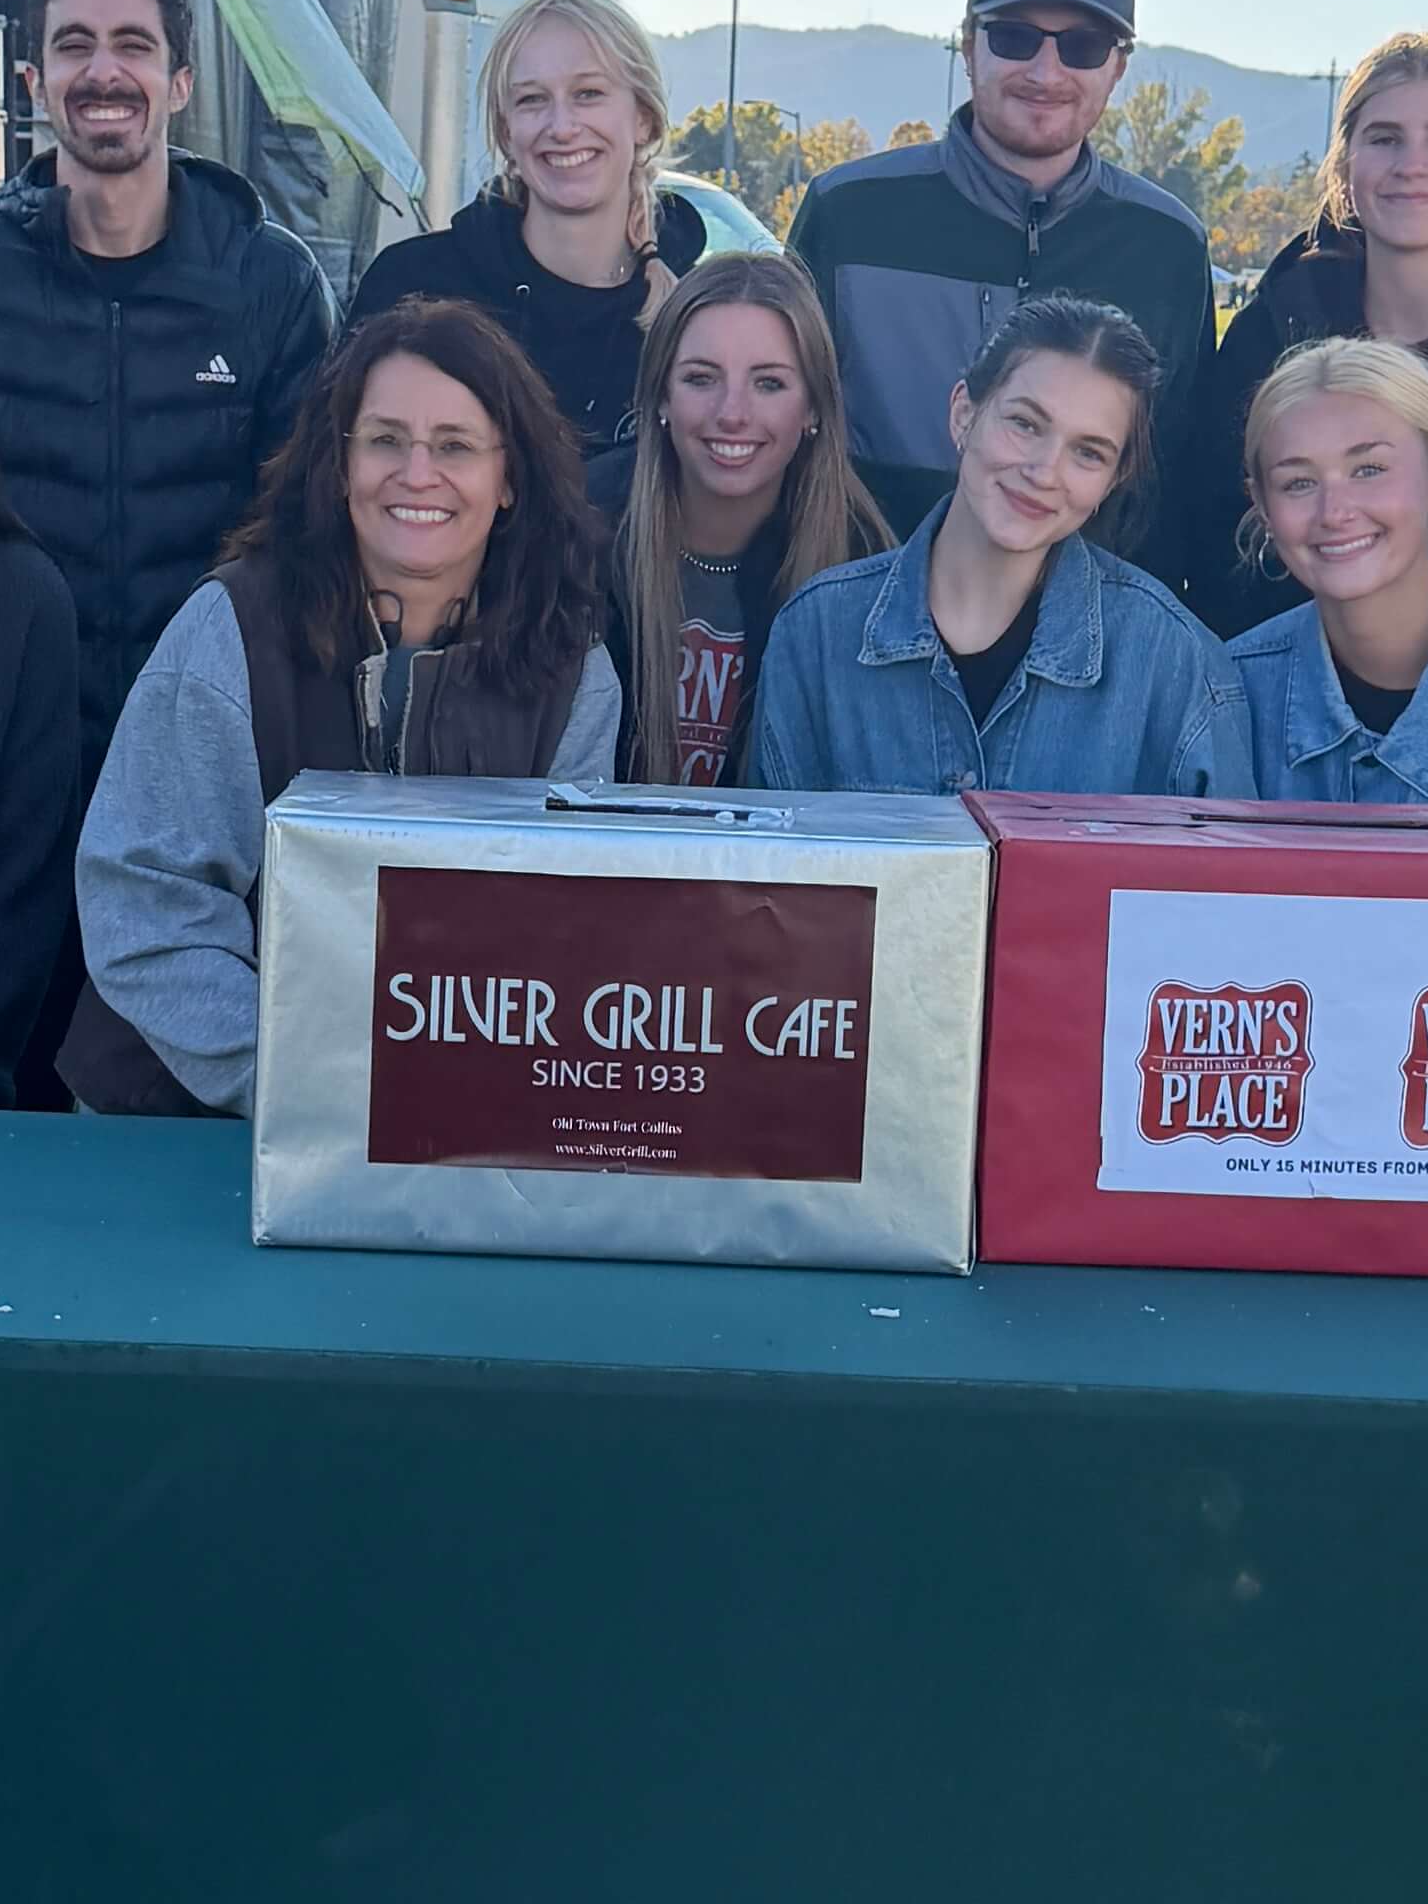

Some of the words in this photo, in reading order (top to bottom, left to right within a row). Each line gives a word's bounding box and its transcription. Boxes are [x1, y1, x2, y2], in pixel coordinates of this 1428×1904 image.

[385, 971, 560, 1046] SILVER
[583, 982, 724, 1055] GRILL
[744, 995, 858, 1060] CAFE
[1157, 998, 1299, 1057] VERN'S
[531, 1059, 622, 1089] SINCE
[634, 1064, 705, 1093] 1933
[1162, 1058, 1250, 1071] Established
[1159, 1073, 1288, 1129] PLACE
[552, 1117, 573, 1130] Old
[576, 1118, 610, 1132] Town
[613, 1120, 637, 1133] Fort
[641, 1121, 683, 1135] Collins
[555, 1143, 677, 1160] www.SilverGrill.com
[1226, 1158, 1271, 1172] ONLY
[1276, 1159, 1294, 1172] 15
[1300, 1159, 1377, 1174] MINUTES
